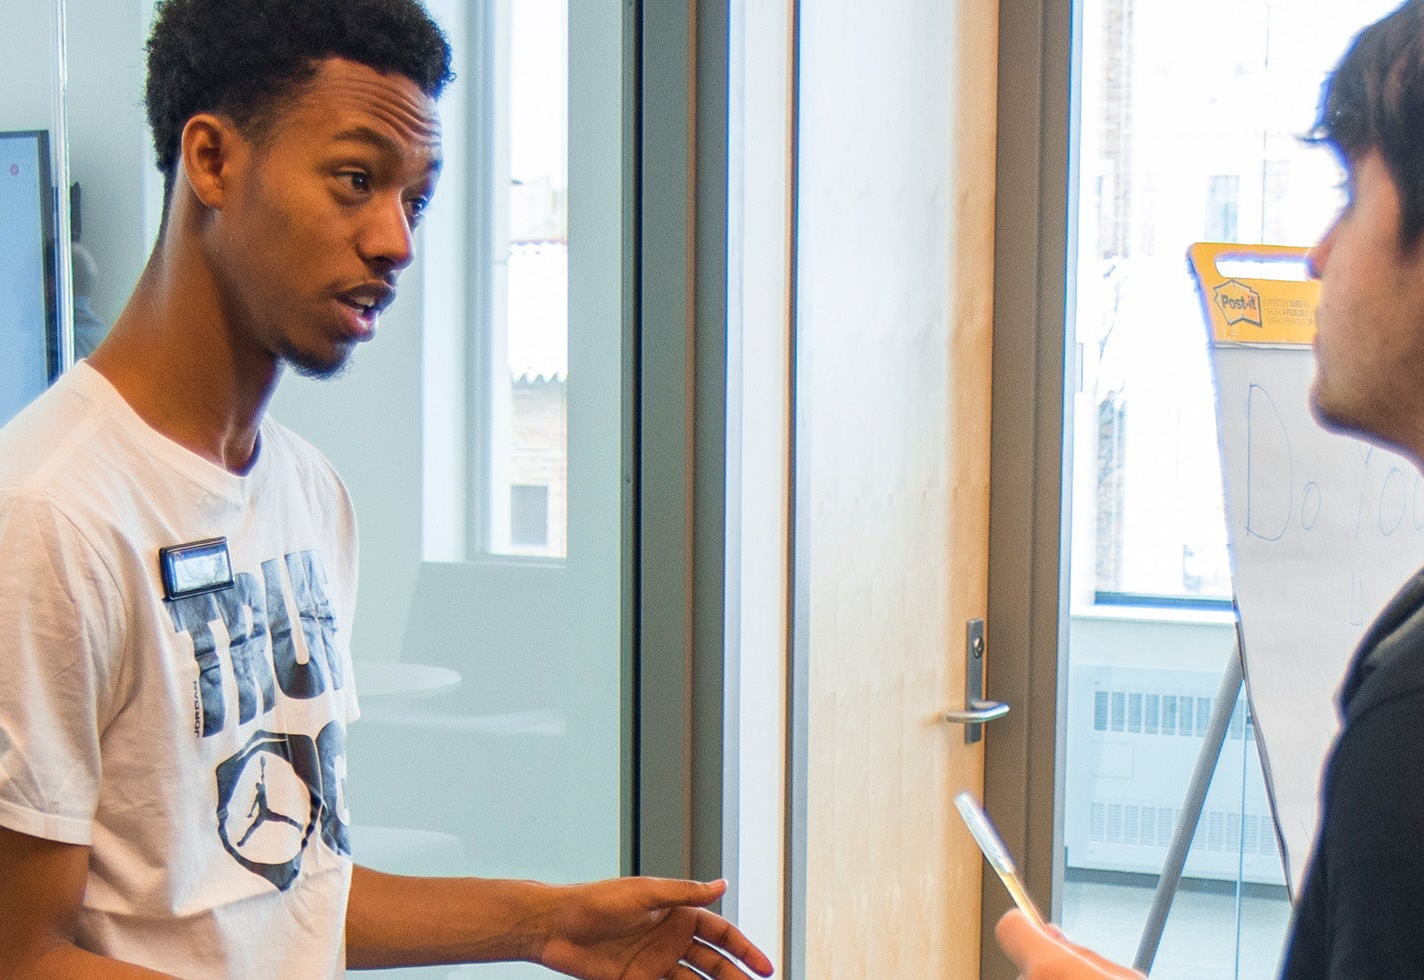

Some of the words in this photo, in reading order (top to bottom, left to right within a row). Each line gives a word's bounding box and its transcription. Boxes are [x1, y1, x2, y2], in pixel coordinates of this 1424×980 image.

[1220, 294, 1257, 311] Post-it
[1244, 382, 1322, 542] Do
[192, 680, 201, 738] JORDAN
